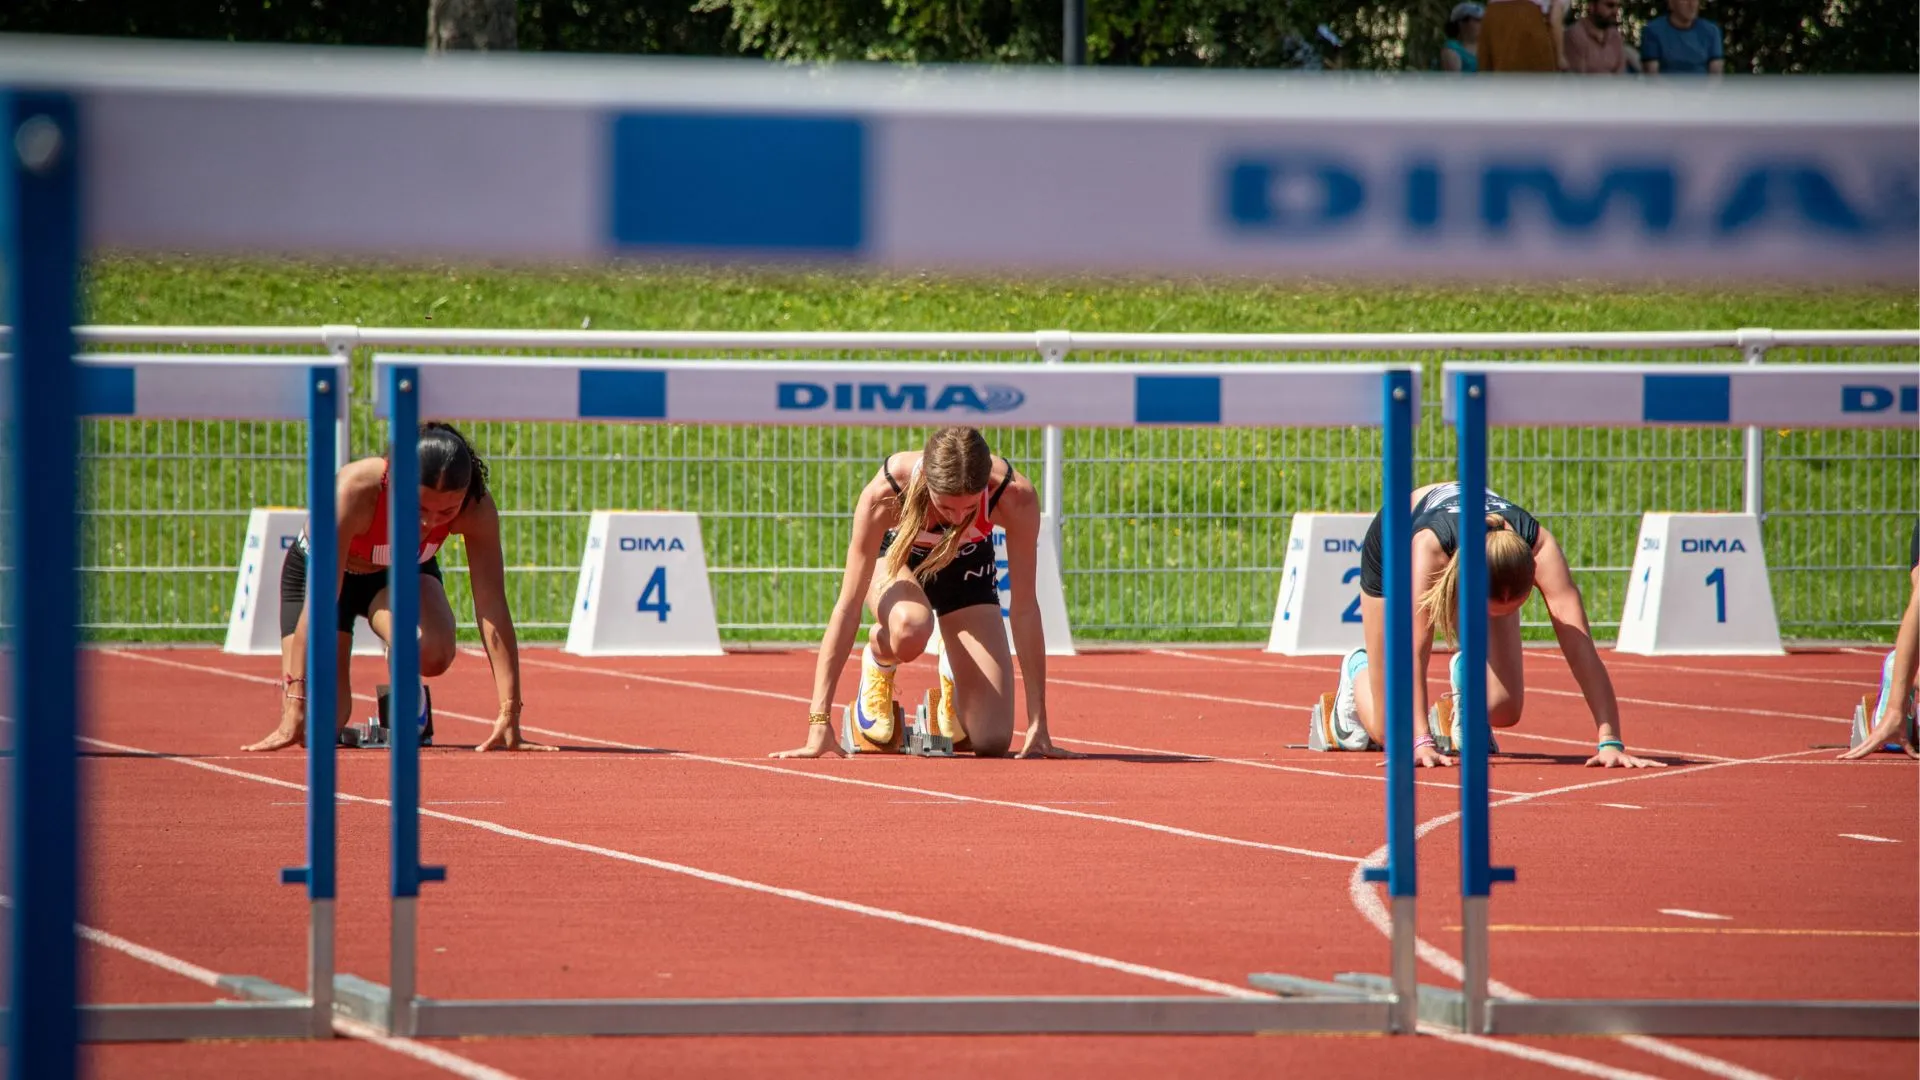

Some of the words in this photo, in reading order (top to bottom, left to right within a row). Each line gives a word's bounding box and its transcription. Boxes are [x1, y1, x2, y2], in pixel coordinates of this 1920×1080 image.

[1226, 159, 1874, 236] DIMA
[776, 382, 988, 414] DIMA
[1840, 384, 1918, 414] DI
[619, 537, 685, 551] DIMA
[1324, 538, 1363, 552] DIM
[1680, 538, 1746, 553] DIMA
[637, 565, 672, 623] 4
[1341, 567, 1363, 623] 2
[1705, 567, 1726, 623] 1
